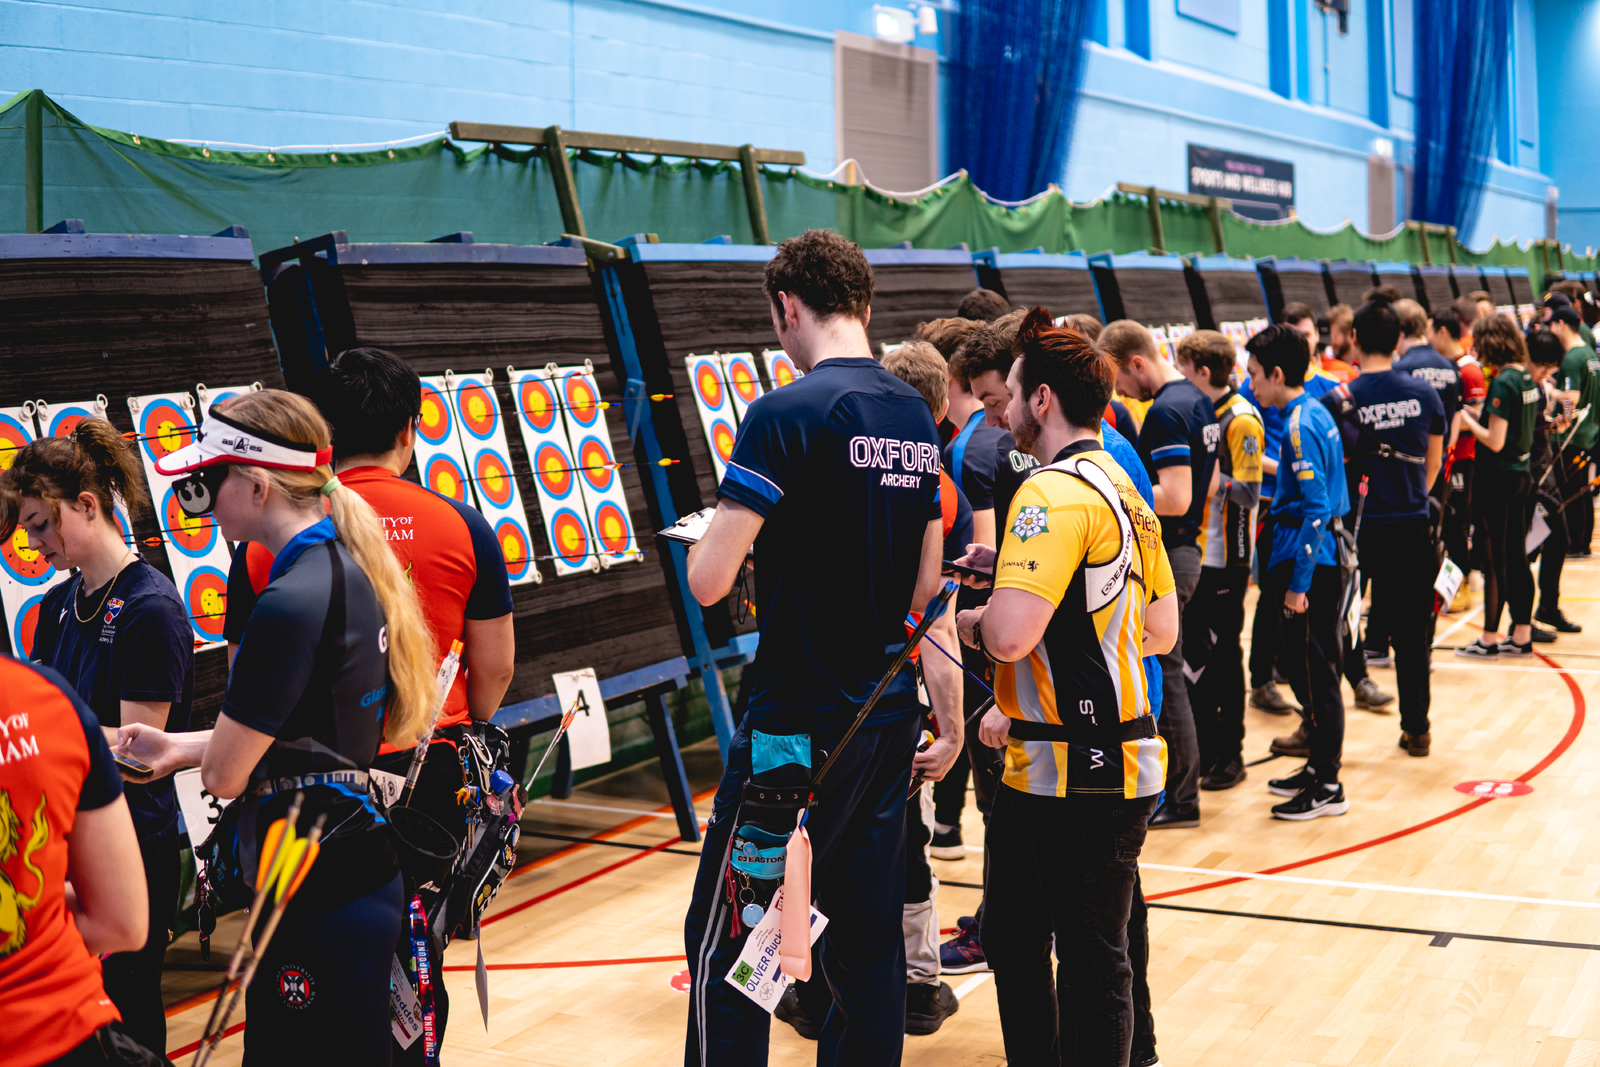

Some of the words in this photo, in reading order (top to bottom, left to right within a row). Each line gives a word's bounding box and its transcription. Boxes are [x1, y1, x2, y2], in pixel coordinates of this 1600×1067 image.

[849, 435, 941, 476] OXFORD
[880, 473, 921, 489] ARCHERY
[399, 516, 414, 525] OF
[1114, 529, 1132, 577] EASTON
[575, 689, 591, 717] 4
[200, 789, 224, 825] 3
[750, 855, 785, 864] EASTON
[416, 940, 430, 985] COMPOUND
[736, 965, 750, 982] 3C
[745, 955, 771, 992] OLIVER
[424, 1015, 435, 1058] COMPOUND
